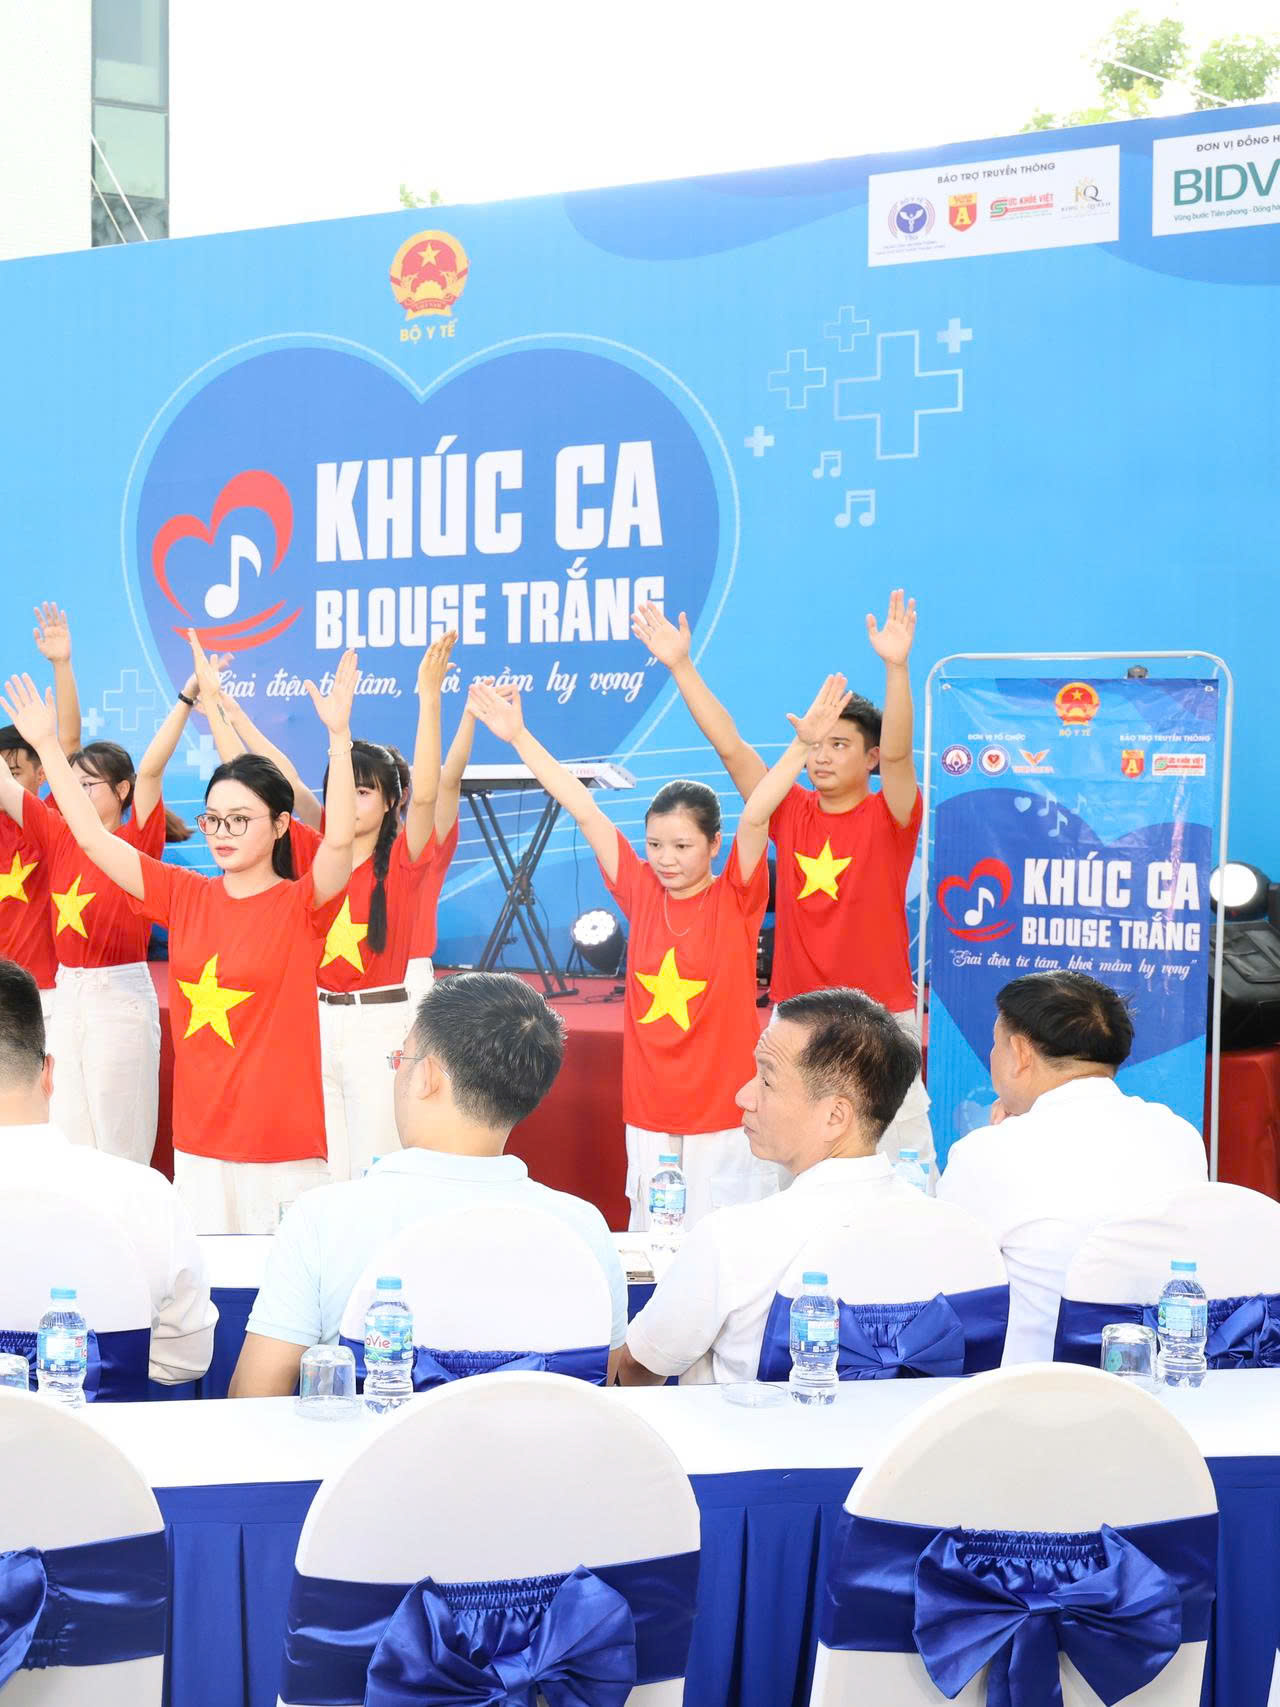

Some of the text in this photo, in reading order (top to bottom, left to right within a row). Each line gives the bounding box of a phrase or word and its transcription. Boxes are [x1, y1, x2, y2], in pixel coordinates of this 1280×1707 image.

[1196, 141, 1220, 153] ĐƠN
[1173, 158, 1280, 206] BIDV
[426, 325, 436, 339] Y
[316, 435, 663, 562] KHÚC CA
[315, 583, 486, 650] BLOUSE
[546, 660, 579, 704] hy
[1023, 851, 1201, 910] KHÚC CA
[1022, 911, 1201, 952] BLOUSE TRẮNG
